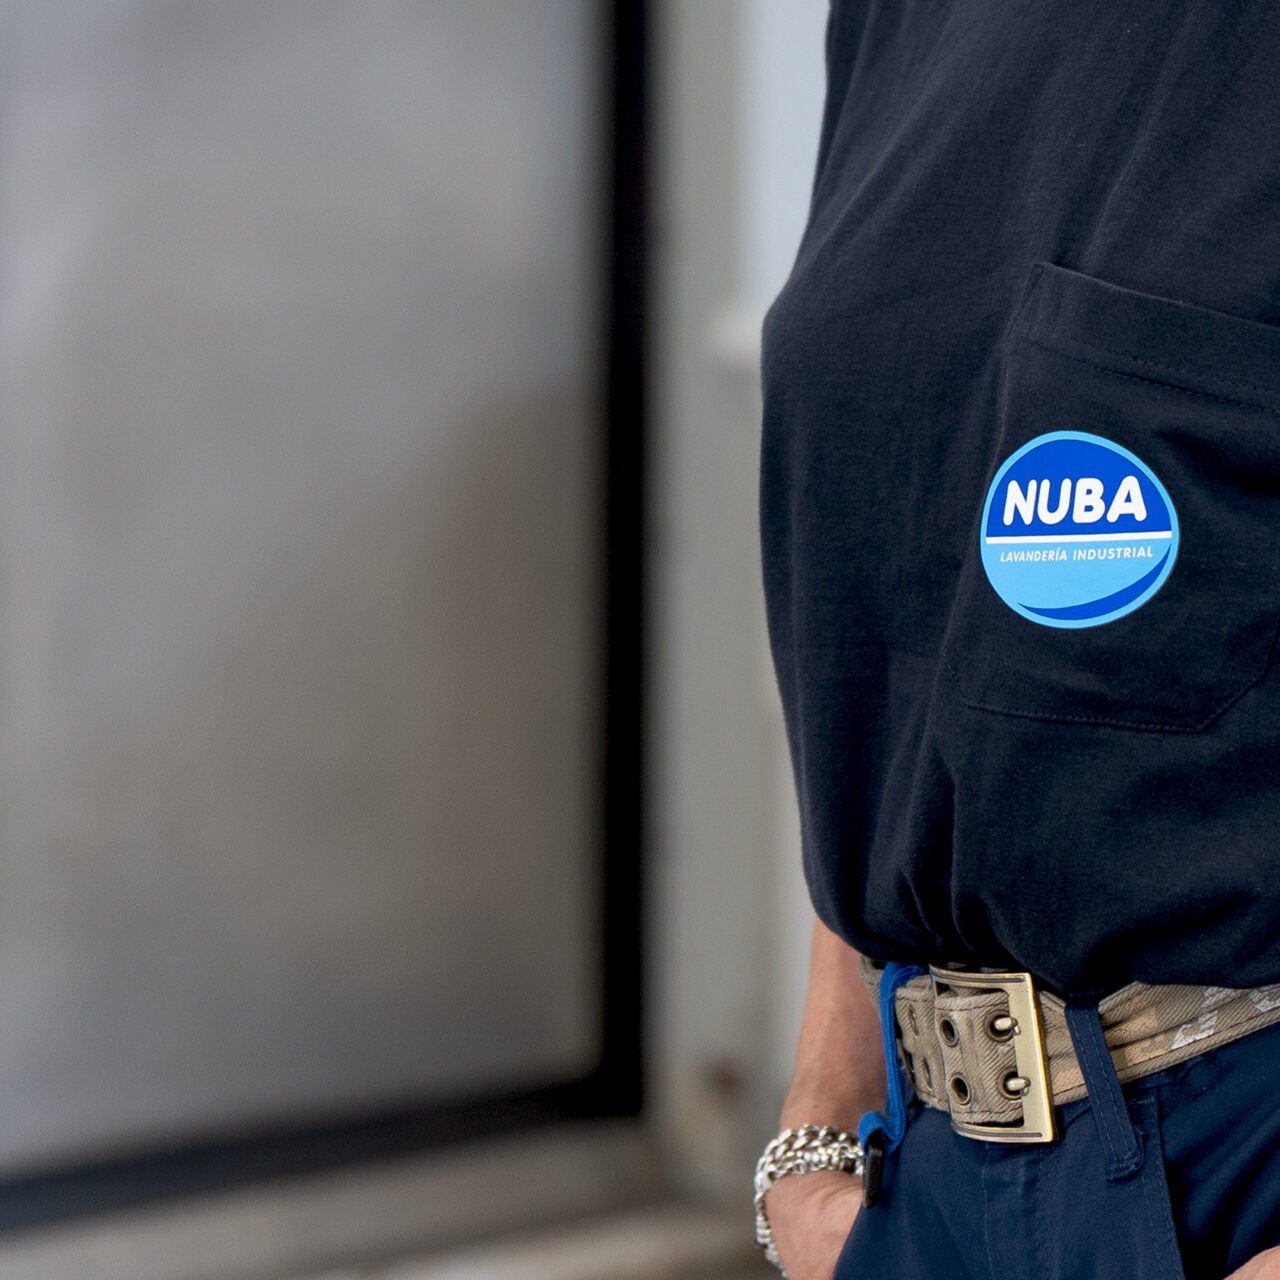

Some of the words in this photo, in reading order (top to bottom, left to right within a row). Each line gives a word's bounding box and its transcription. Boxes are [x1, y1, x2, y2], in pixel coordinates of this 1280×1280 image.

[1003, 475, 1147, 526] NUBA
[1000, 547, 1068, 563] LAVANDERÍA
[1072, 546, 1154, 560] INDUSTRIAL
